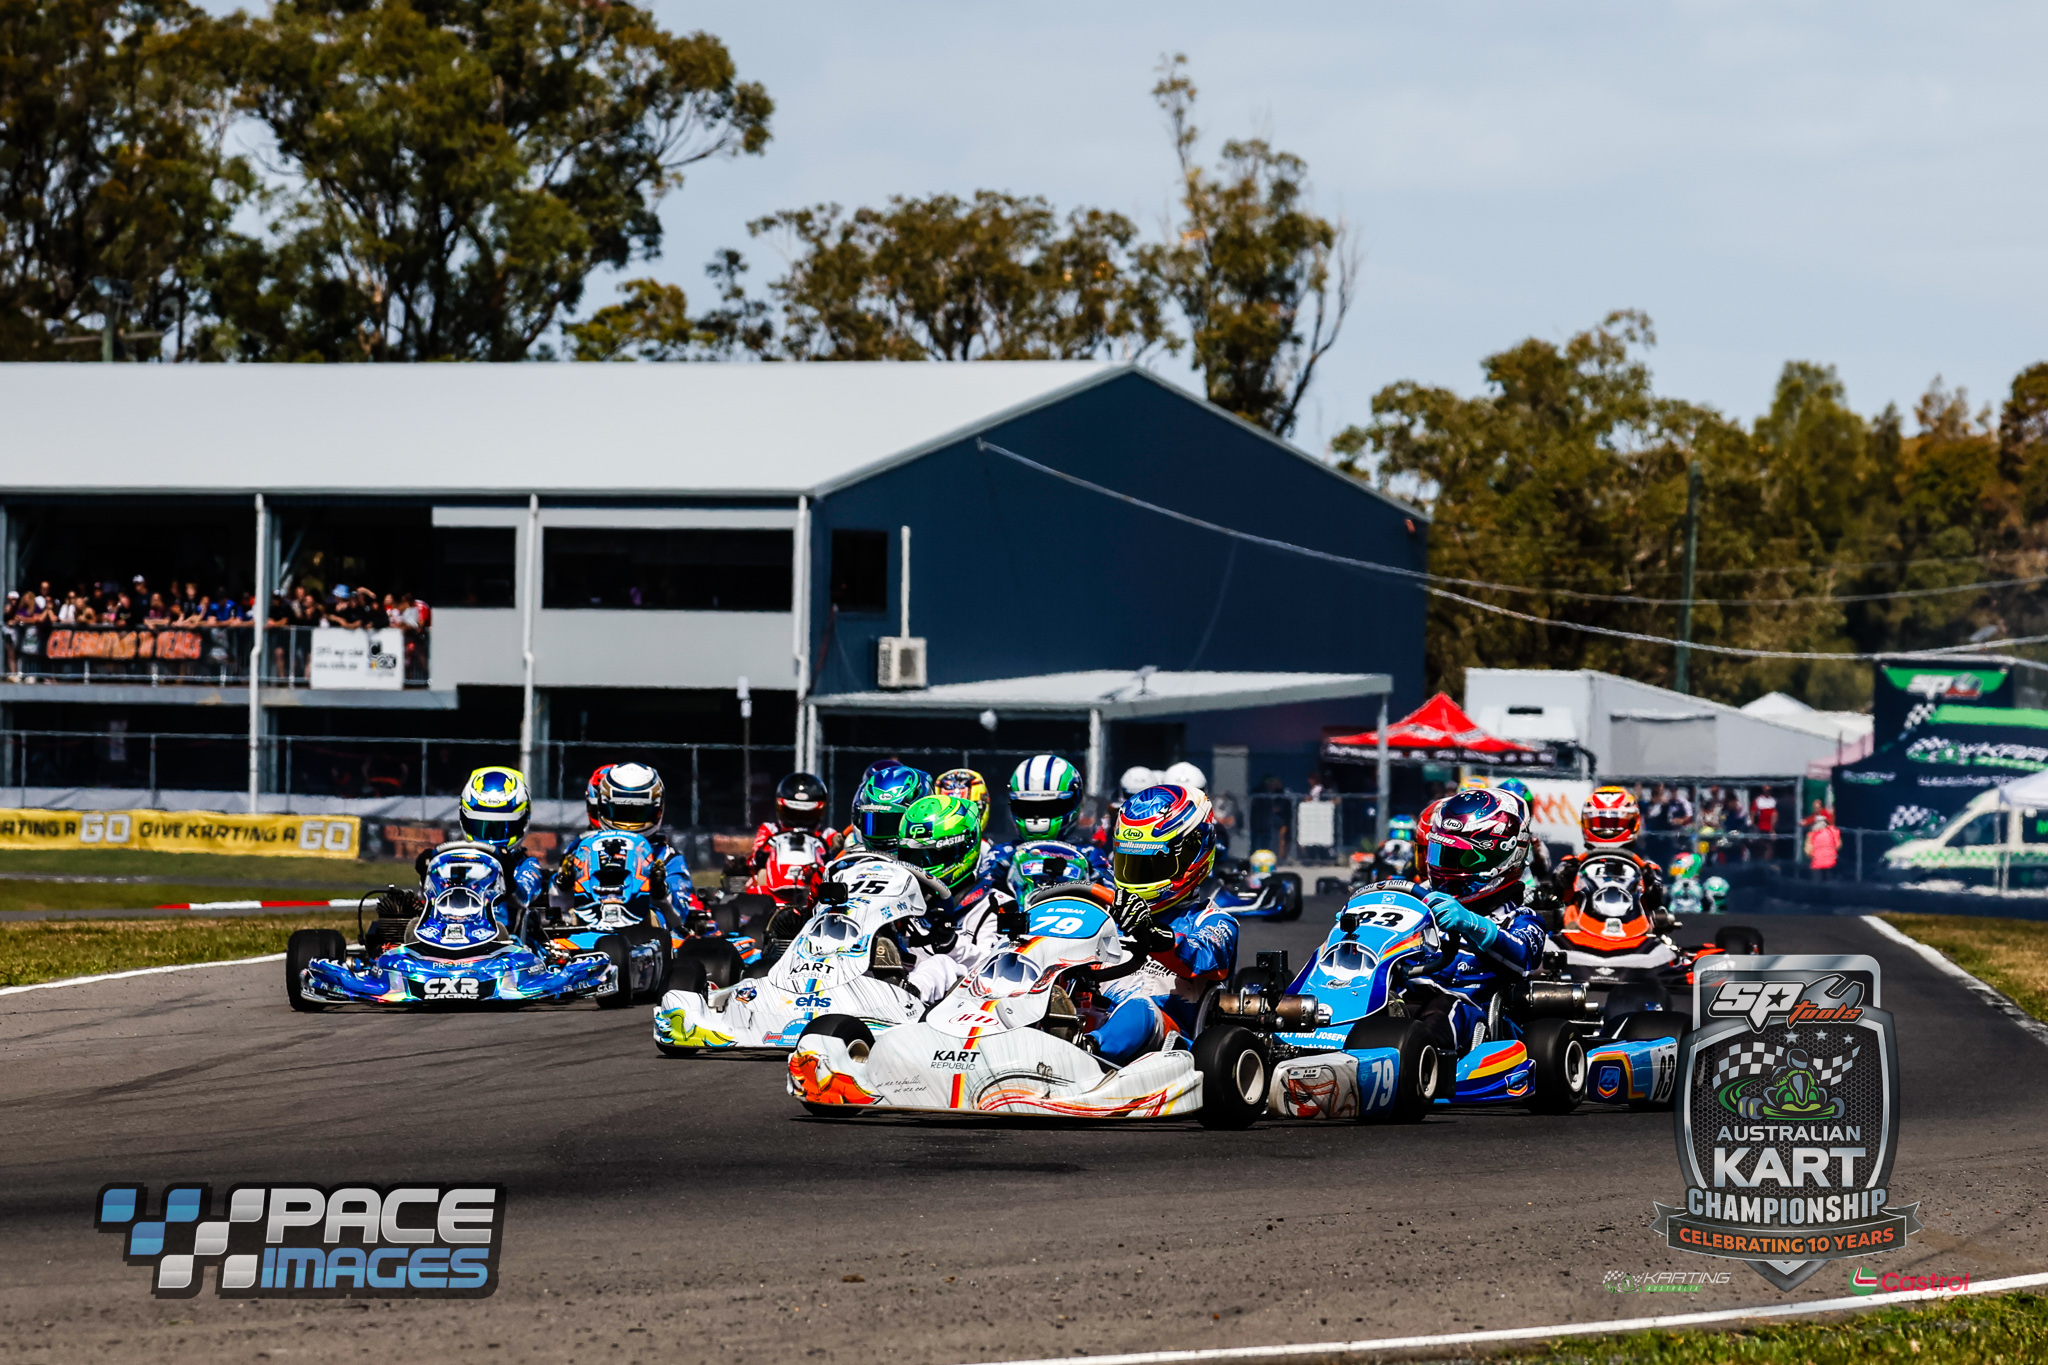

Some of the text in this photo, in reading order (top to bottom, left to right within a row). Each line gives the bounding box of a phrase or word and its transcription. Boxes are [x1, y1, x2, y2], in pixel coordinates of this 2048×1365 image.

[0, 813, 132, 843] RTING A GO
[1444, 818, 1461, 829] Arai
[139, 820, 352, 851] GIVE KARTING A GO
[1124, 828, 1141, 839] Arai
[848, 880, 889, 894] 15
[1029, 915, 1083, 935] 79
[790, 962, 835, 975] KART
[423, 977, 480, 994] CXR
[795, 993, 832, 1008] ehs
[1316, 1032, 1347, 1042] JOSEPH
[933, 1051, 980, 1063] KART
[930, 1061, 976, 1071] REPUBLIC
[1366, 1058, 1395, 1111] 79
